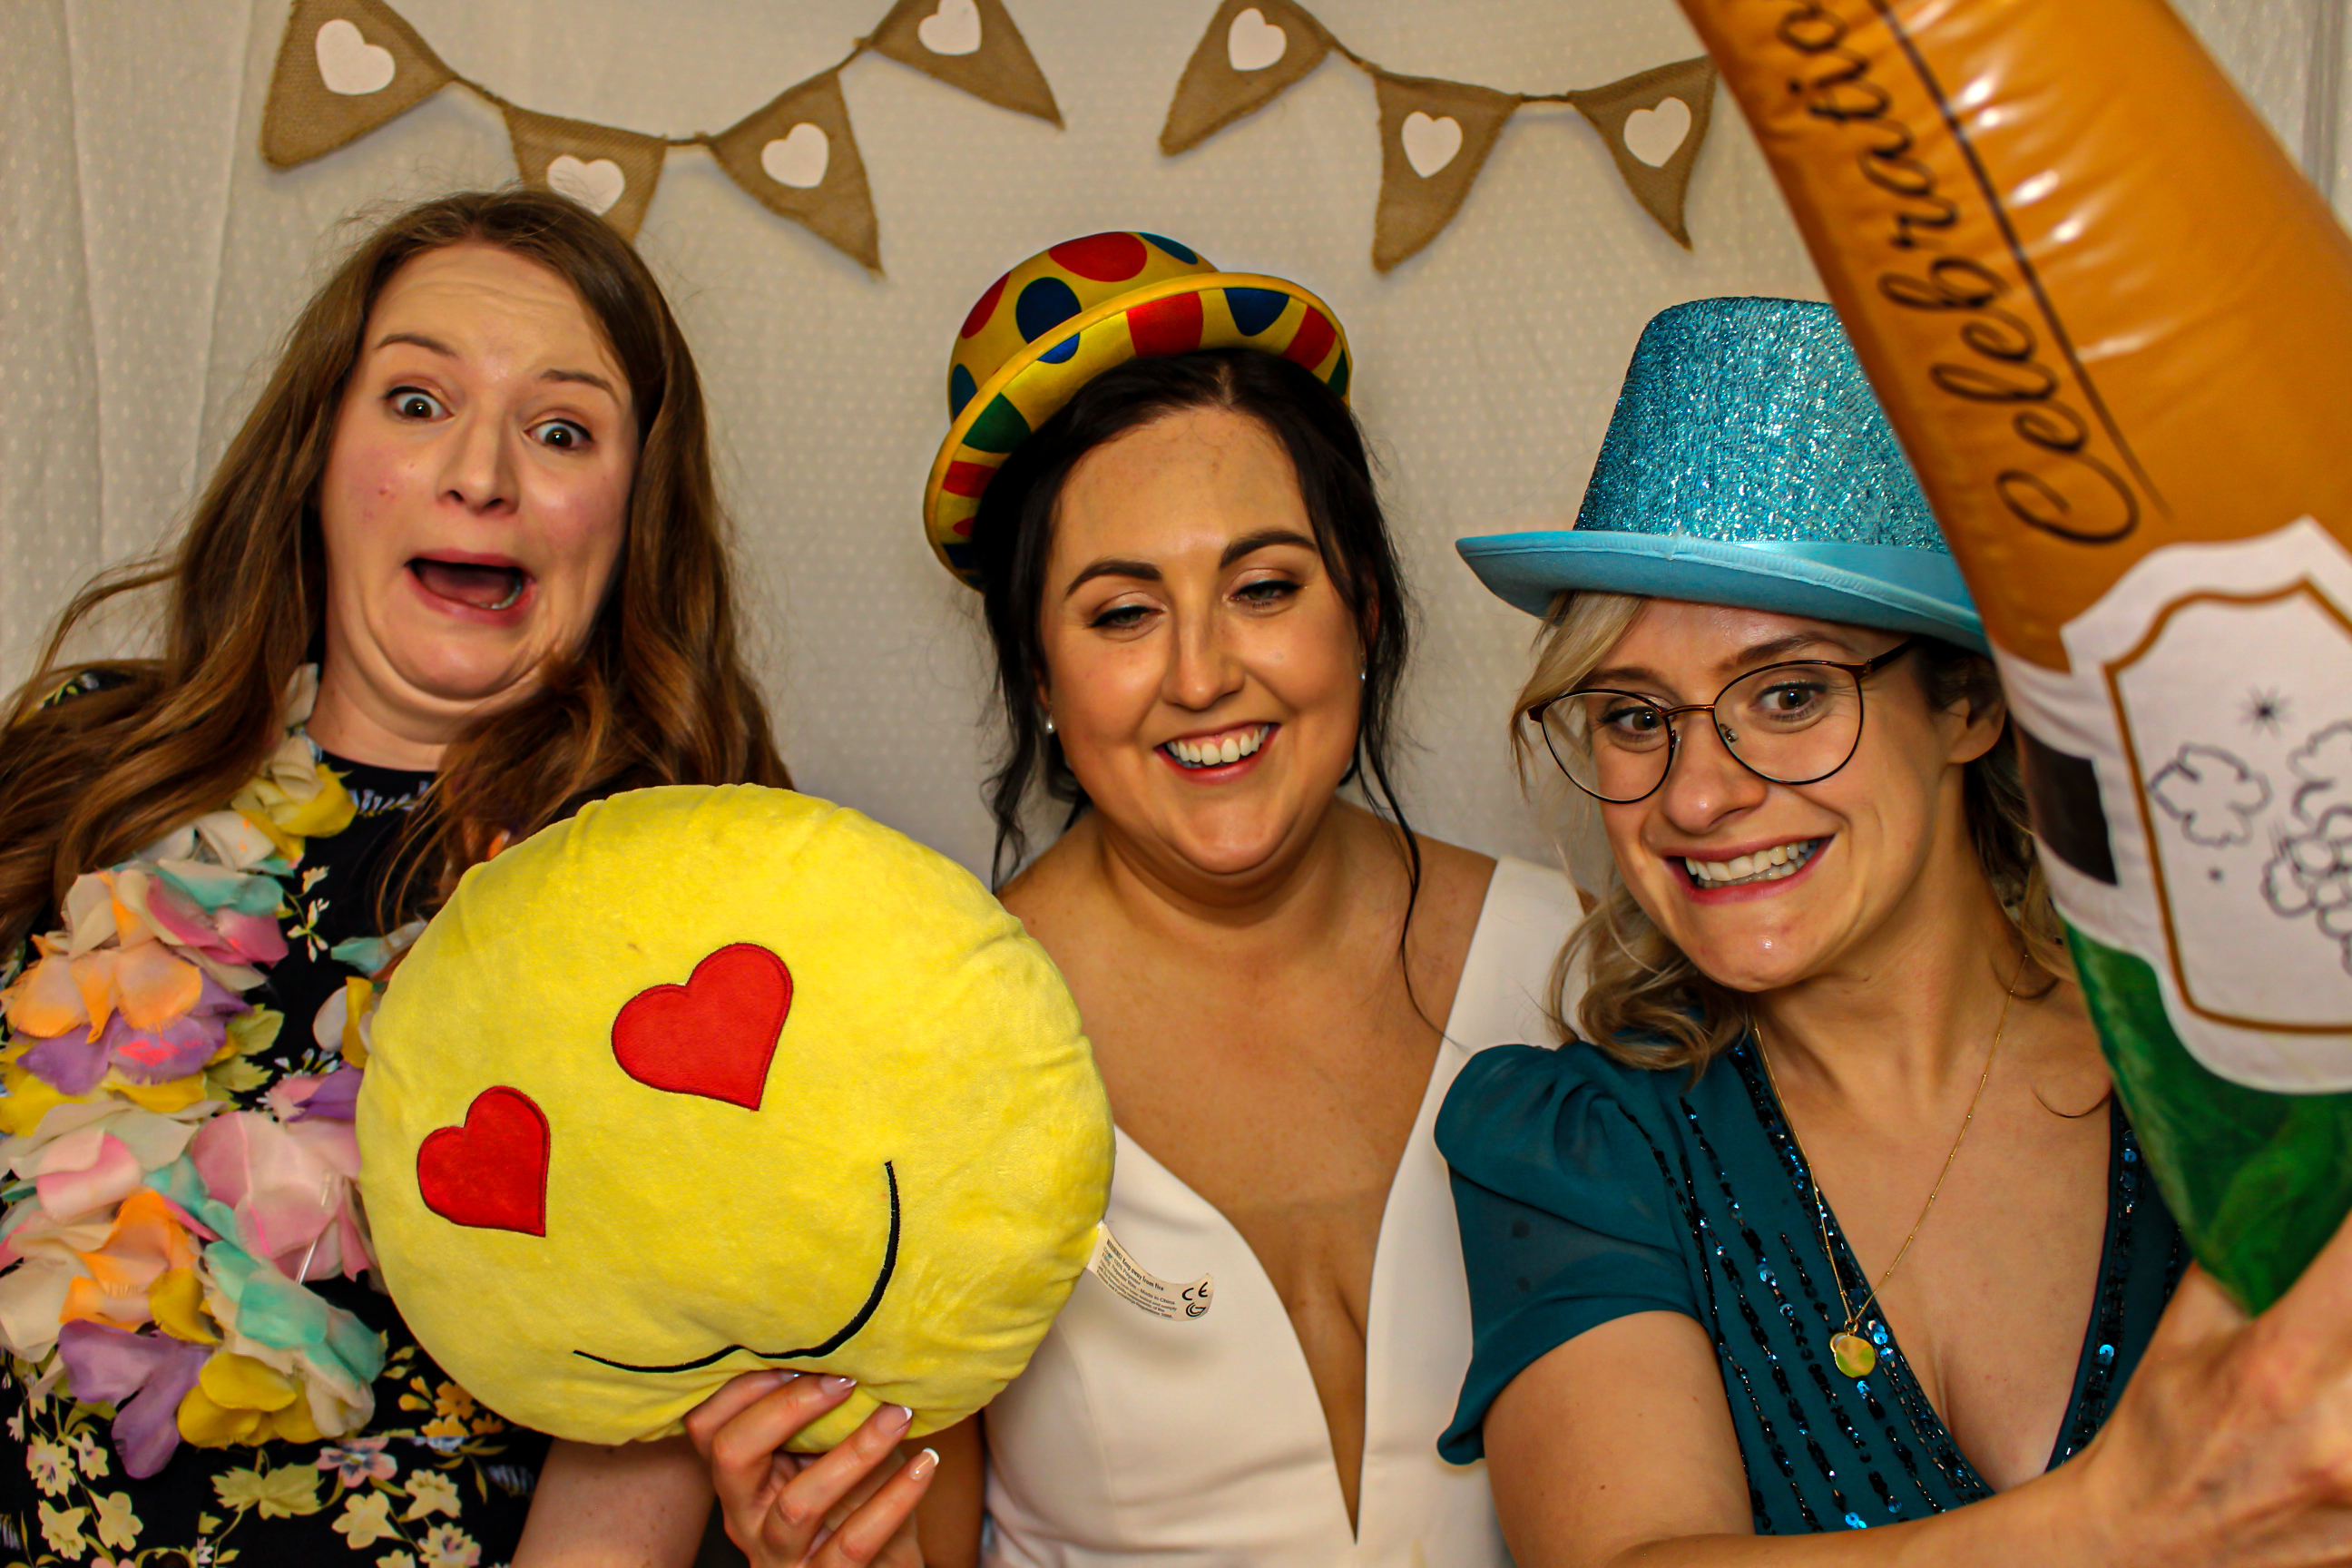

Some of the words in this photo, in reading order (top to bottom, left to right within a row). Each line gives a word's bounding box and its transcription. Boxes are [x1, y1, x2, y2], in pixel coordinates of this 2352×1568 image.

[1775, 0, 2140, 545] Celebratio
[1131, 1268, 1142, 1280] away
[1142, 1275, 1154, 1288] from
[1154, 1282, 1164, 1291] fire
[1160, 1297, 1176, 1306] China
